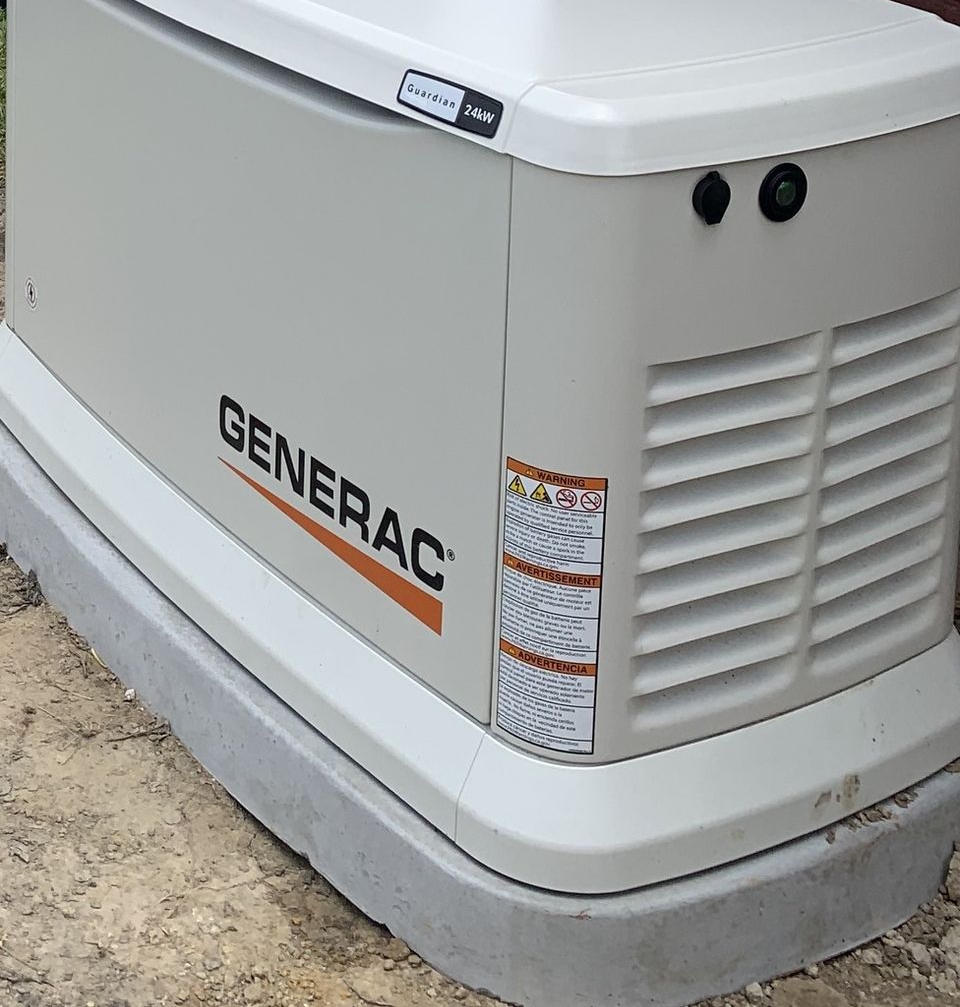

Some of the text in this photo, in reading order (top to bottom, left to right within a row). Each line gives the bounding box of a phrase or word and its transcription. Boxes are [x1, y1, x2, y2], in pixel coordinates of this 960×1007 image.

[407, 83, 456, 109] Guardian
[463, 104, 495, 124] 24kW
[537, 471, 586, 487] WARNING
[516, 562, 598, 586] AVERTISSEMENT
[518, 651, 588, 674] ADVERTENCIA
